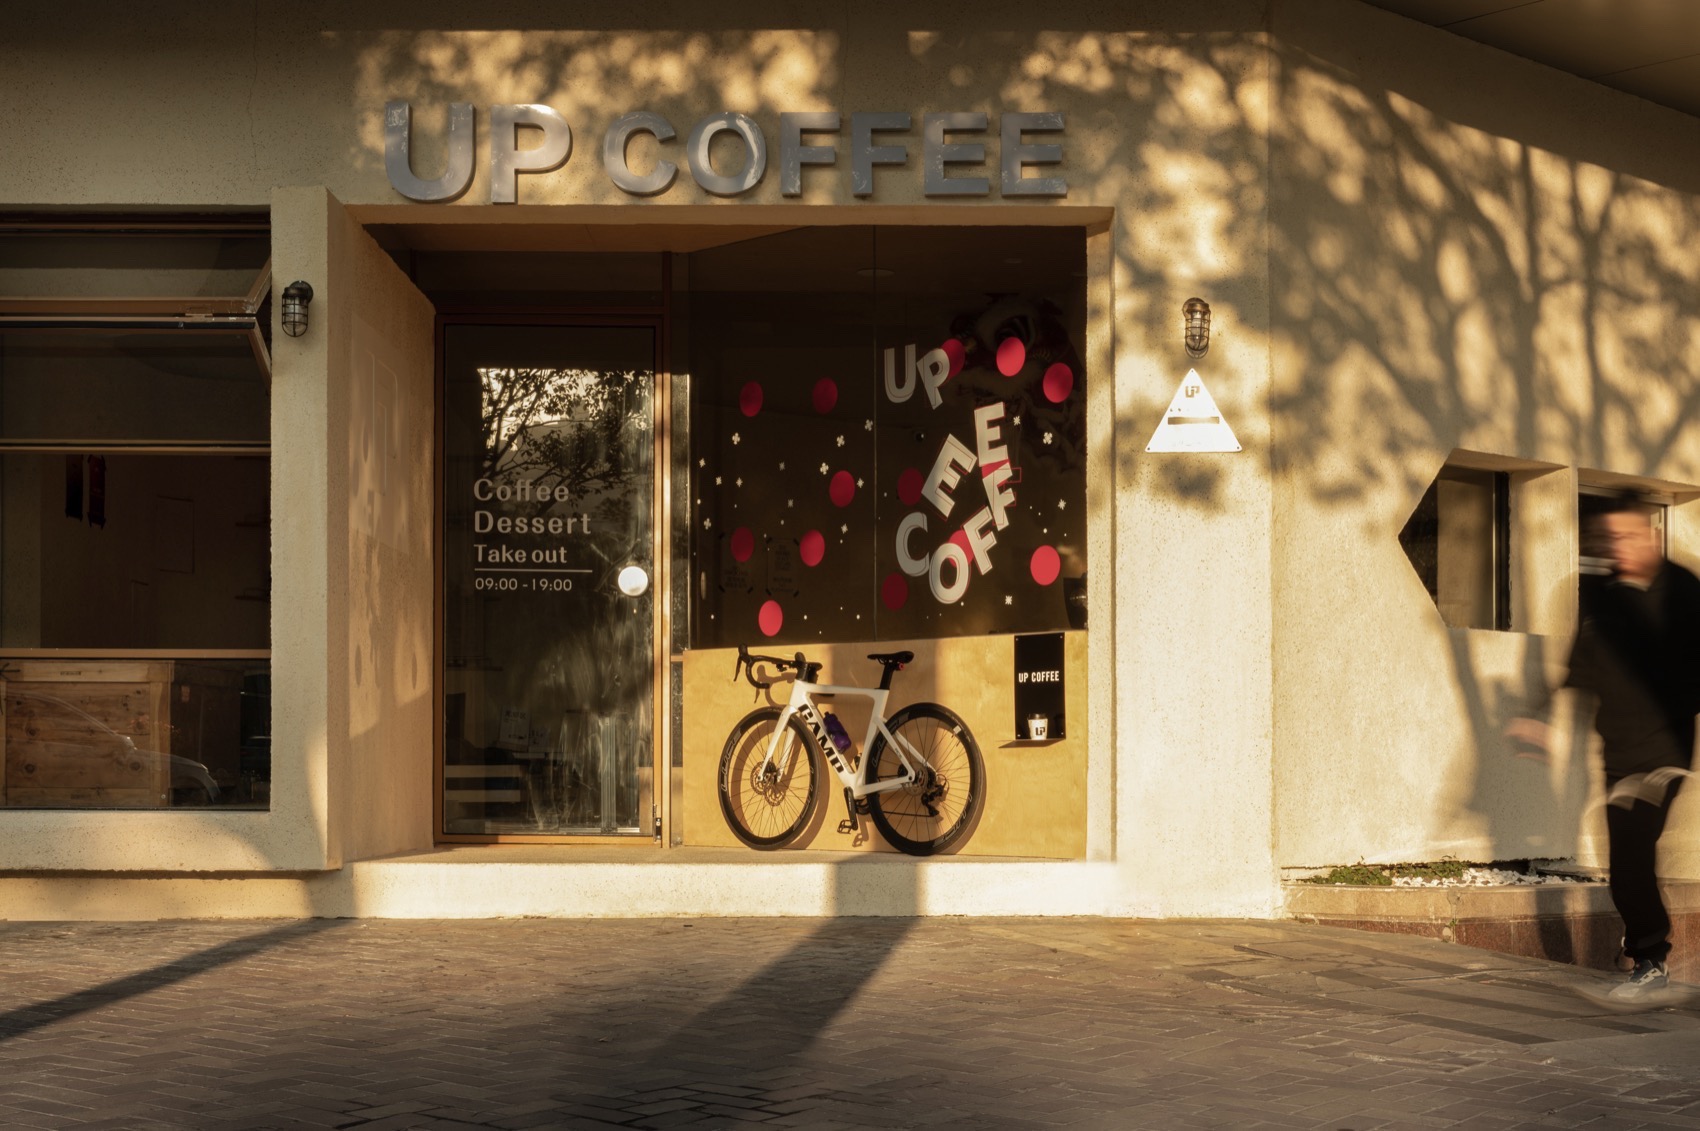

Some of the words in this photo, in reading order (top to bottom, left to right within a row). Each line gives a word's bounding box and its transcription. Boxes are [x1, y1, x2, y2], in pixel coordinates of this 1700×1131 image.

[384, 102, 573, 204] UP
[603, 111, 1067, 198] COFFEE
[884, 343, 950, 410] UP
[473, 478, 570, 501] Coffee
[474, 511, 592, 534] Dessert
[473, 544, 527, 563] Take
[531, 546, 568, 564] out
[1018, 672, 1029, 683] UP
[1031, 670, 1060, 683] COFFEE
[798, 704, 845, 773] CAMP
